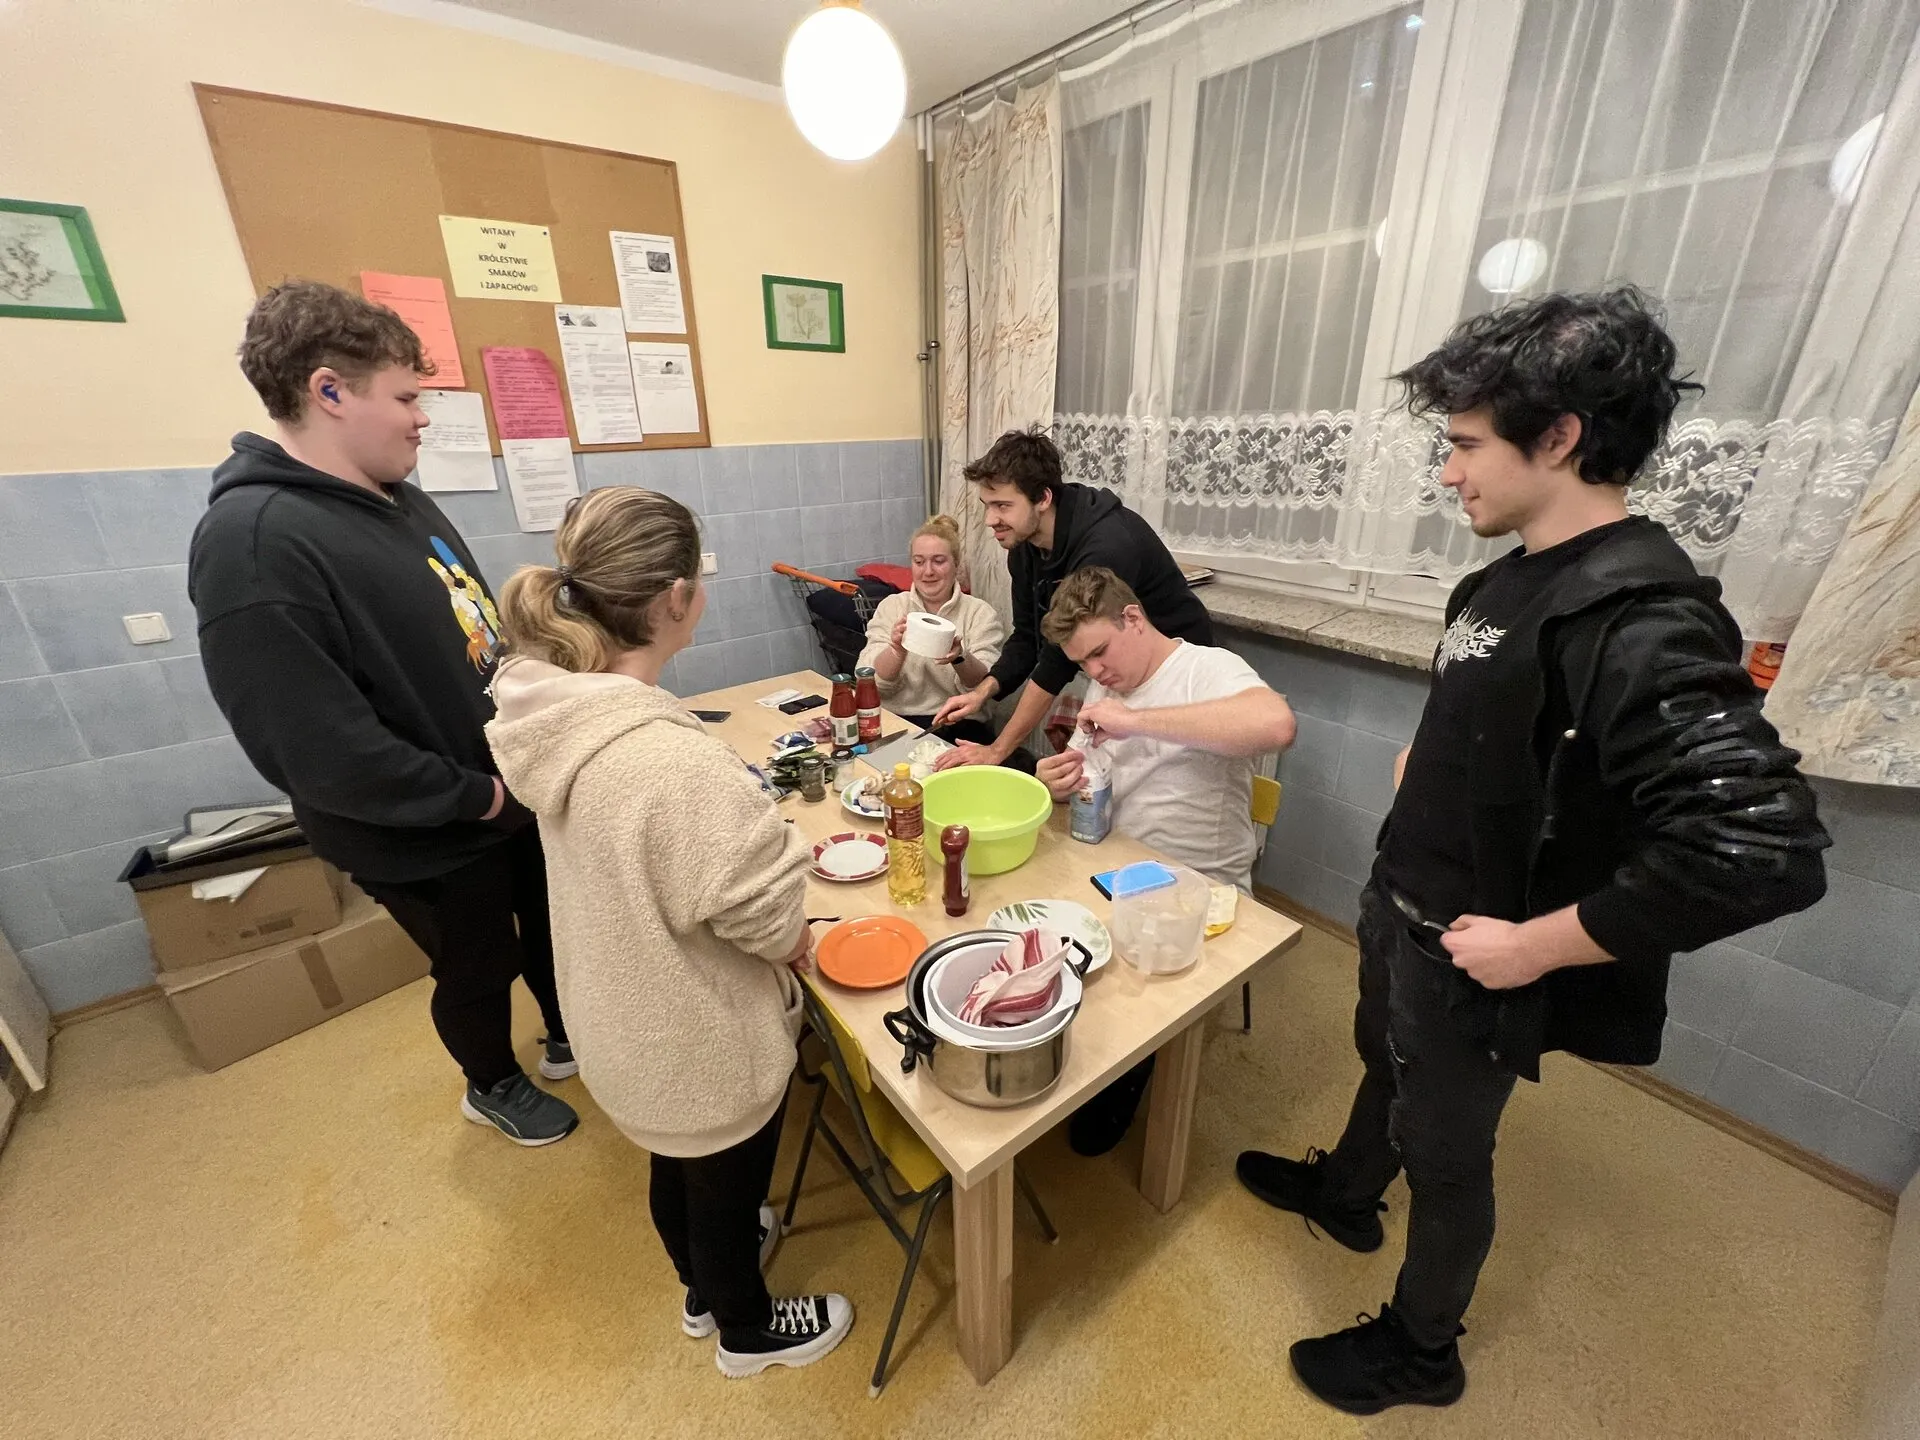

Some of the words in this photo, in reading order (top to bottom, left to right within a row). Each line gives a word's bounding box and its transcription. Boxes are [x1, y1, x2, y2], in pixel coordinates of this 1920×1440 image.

[480, 227, 516, 237] WITAMY
[497, 242, 506, 250] W
[478, 254, 528, 265] KRÓLESTWIE
[488, 268, 526, 278] SMAKÓW
